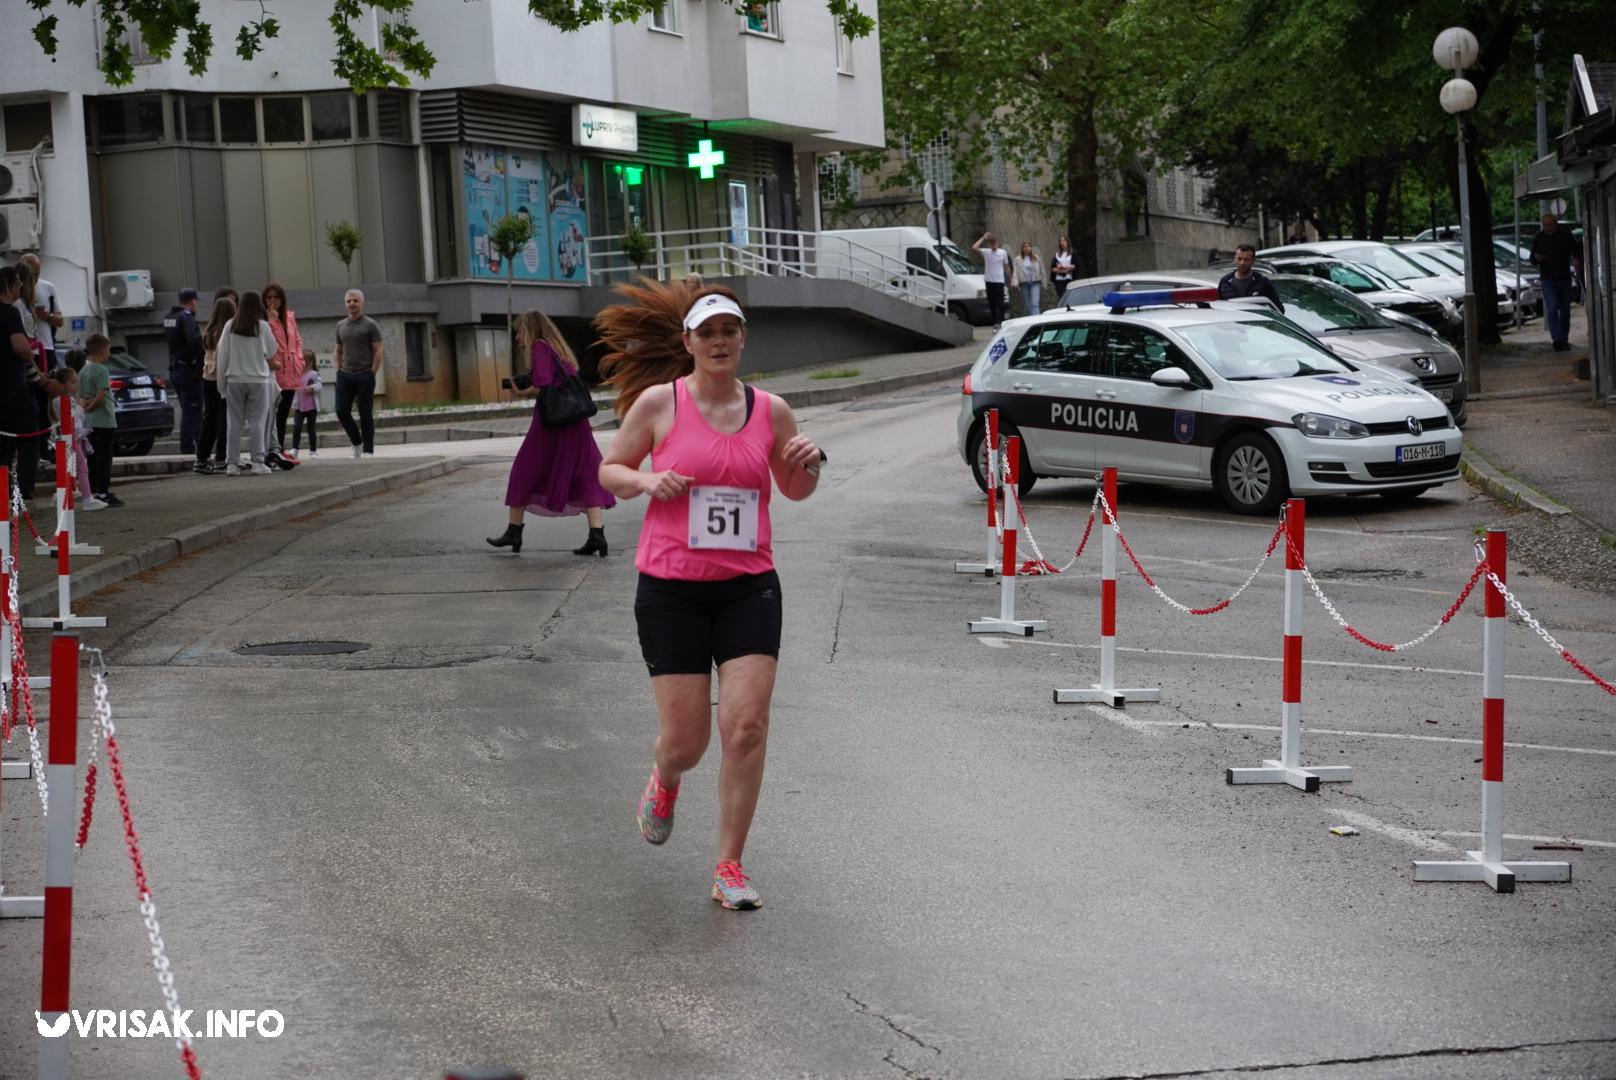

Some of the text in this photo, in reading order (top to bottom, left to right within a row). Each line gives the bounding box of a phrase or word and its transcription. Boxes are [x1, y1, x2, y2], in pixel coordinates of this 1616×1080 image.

[1051, 403, 1138, 432] POLICIJA
[1403, 446, 1444, 461] 016-M-118
[707, 506, 740, 536] 51
